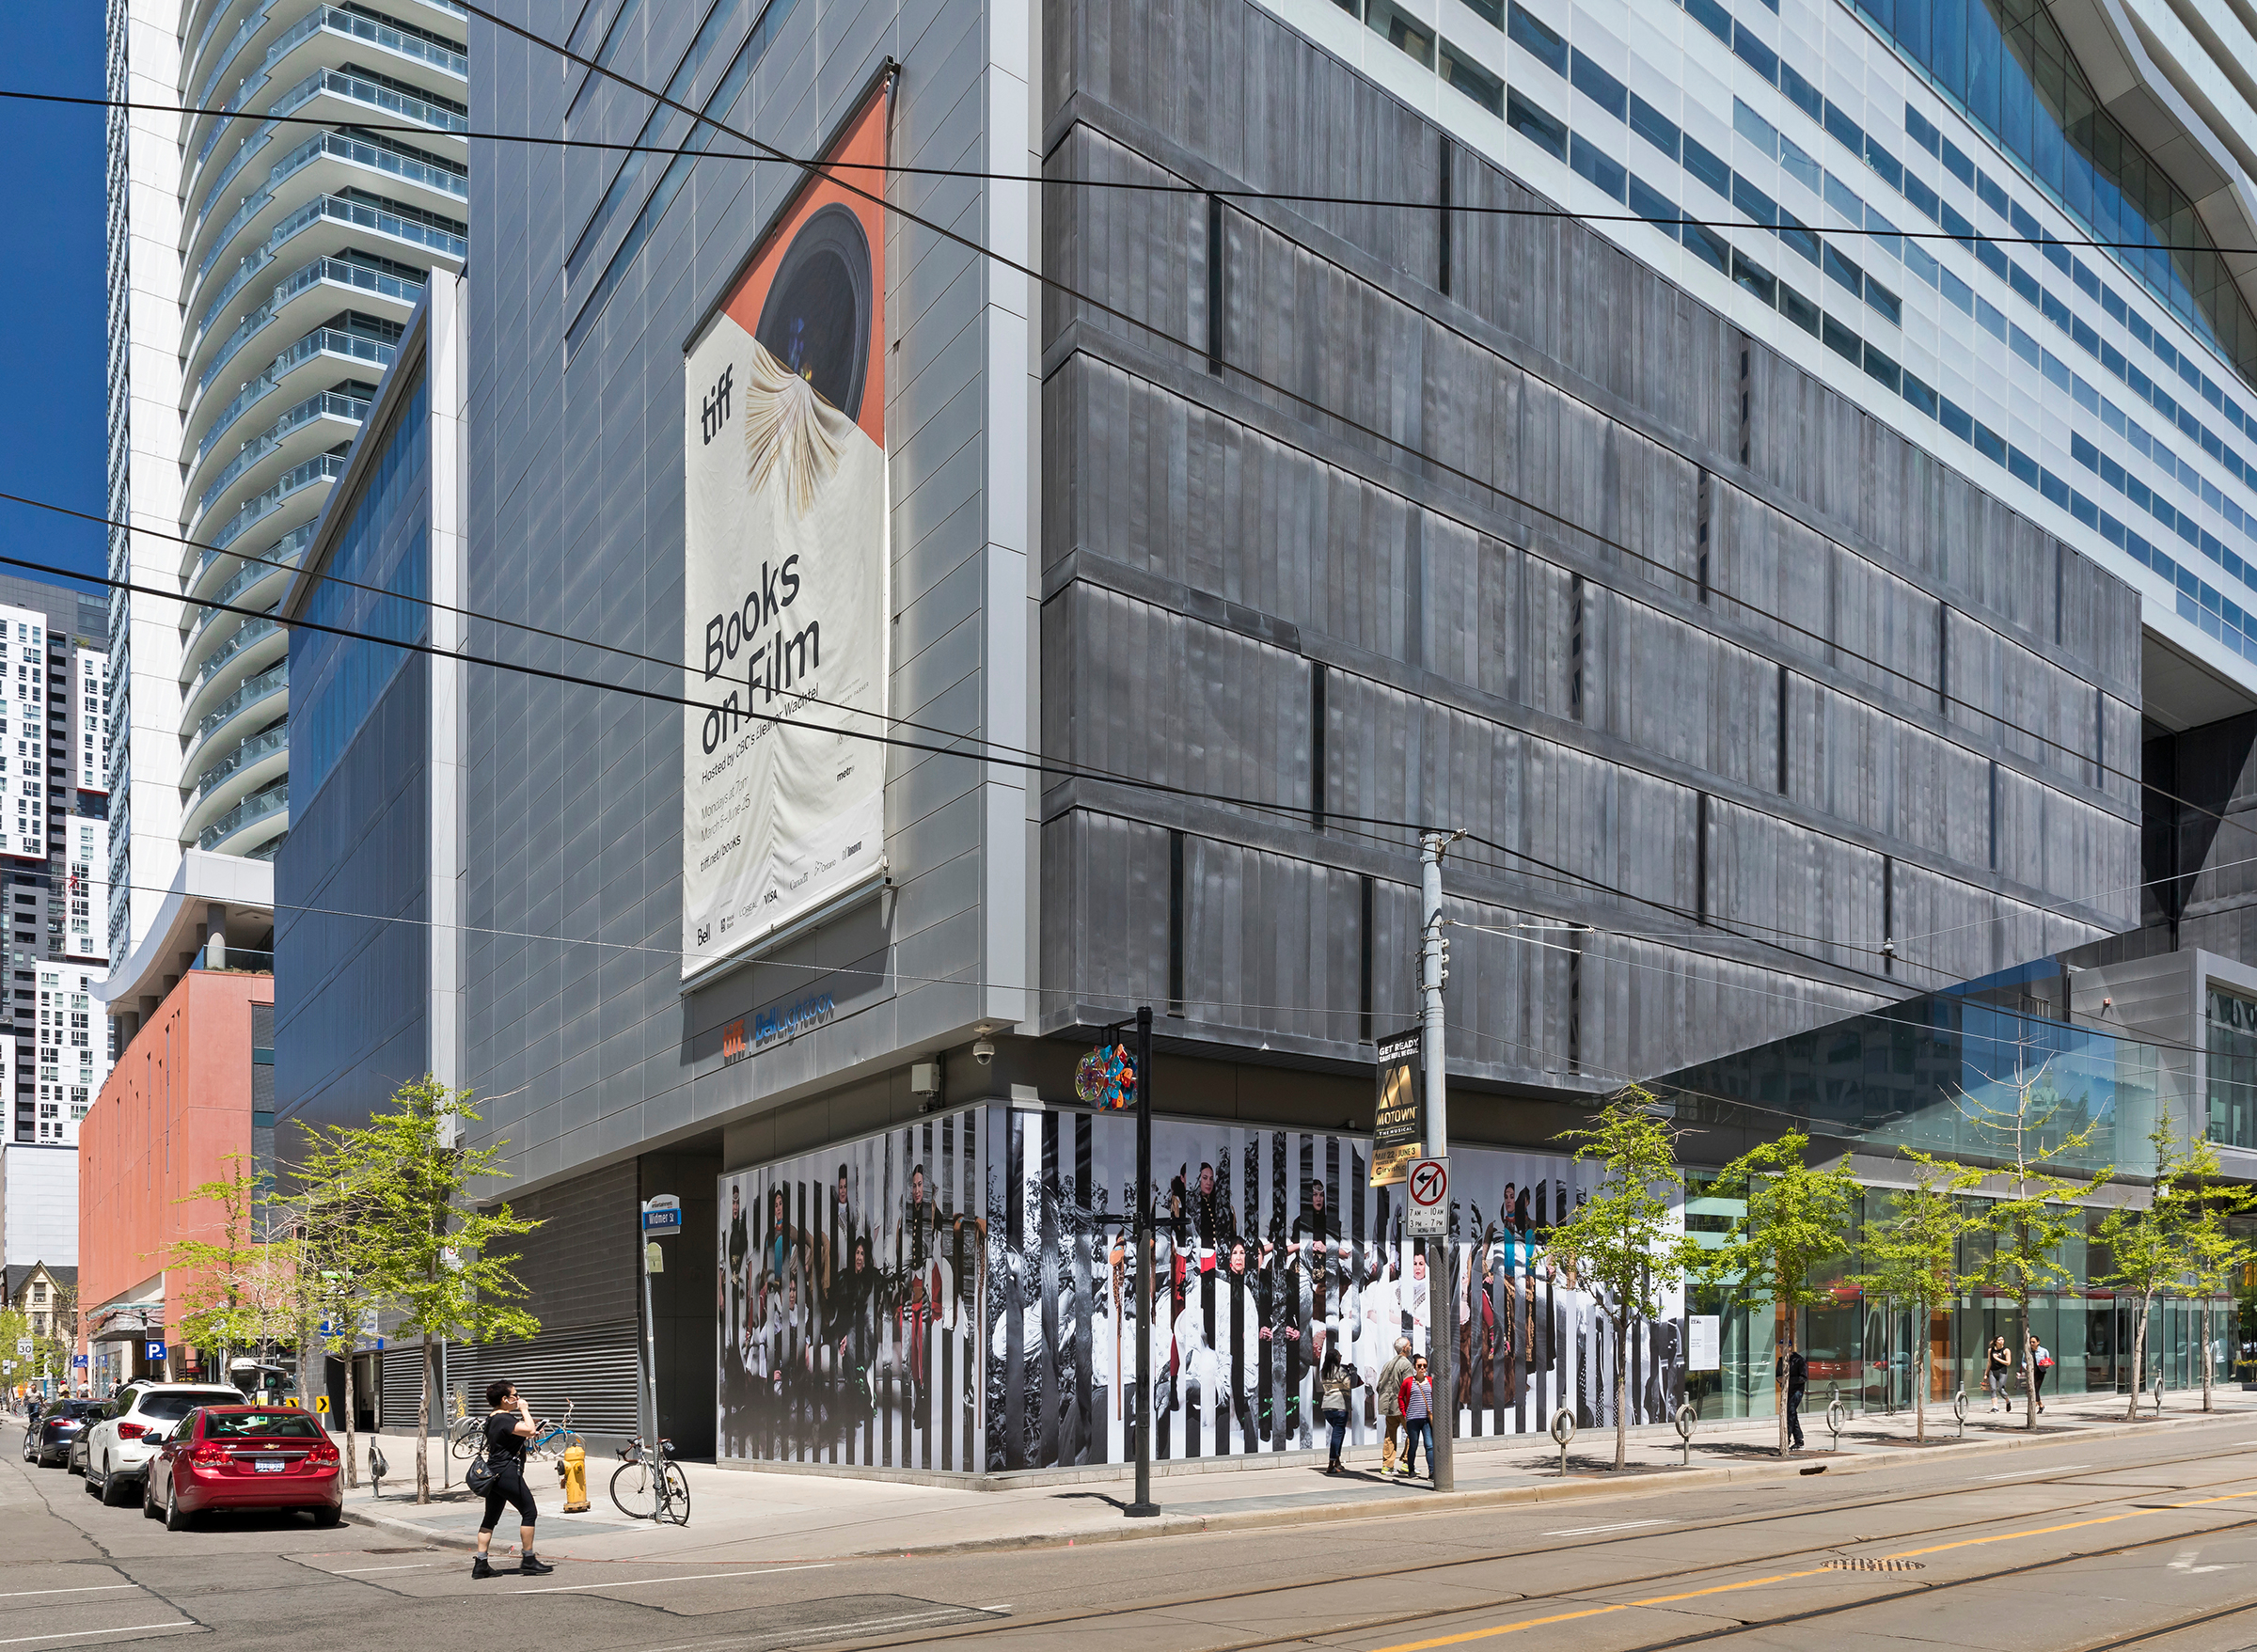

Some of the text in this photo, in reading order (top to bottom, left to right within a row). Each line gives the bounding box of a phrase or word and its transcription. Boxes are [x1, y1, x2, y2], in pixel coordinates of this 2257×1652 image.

[701, 362, 734, 446] tiff
[705, 553, 800, 683] Books
[702, 620, 820, 755] on Film
[702, 755, 726, 784] Hosted
[727, 749, 734, 767] by
[735, 733, 755, 758] CBC's
[755, 710, 783, 739] Eleanor
[784, 682, 818, 717] Wachtel
[701, 776, 750, 821] Mondays at 7pm
[701, 820, 720, 843] March
[741, 793, 751, 812] 25
[700, 834, 742, 873] tiff.net/books
[821, 858, 837, 873] Ontario
[789, 871, 809, 891] Canada
[764, 889, 779, 905] VISA
[697, 922, 711, 947] Bell
[777, 990, 835, 1035] Lightbox
[1379, 1045, 1394, 1055] GET
[1377, 1107, 1415, 1125] MOTOWN
[1375, 1152, 1387, 1161] MAY
[1386, 1151, 1395, 1159] 22
[1397, 1148, 1412, 1157] JUNE
[1411, 1147, 1416, 1156] 3
[648, 1212, 674, 1225] Widmer St
[1409, 1208, 1414, 1217] 7
[1429, 1206, 1437, 1216] 10
[1409, 1219, 1414, 1228] 3
[1430, 1219, 1435, 1227] 7
[19, 1345, 32, 1354] 30
[149, 1344, 161, 1359] P
